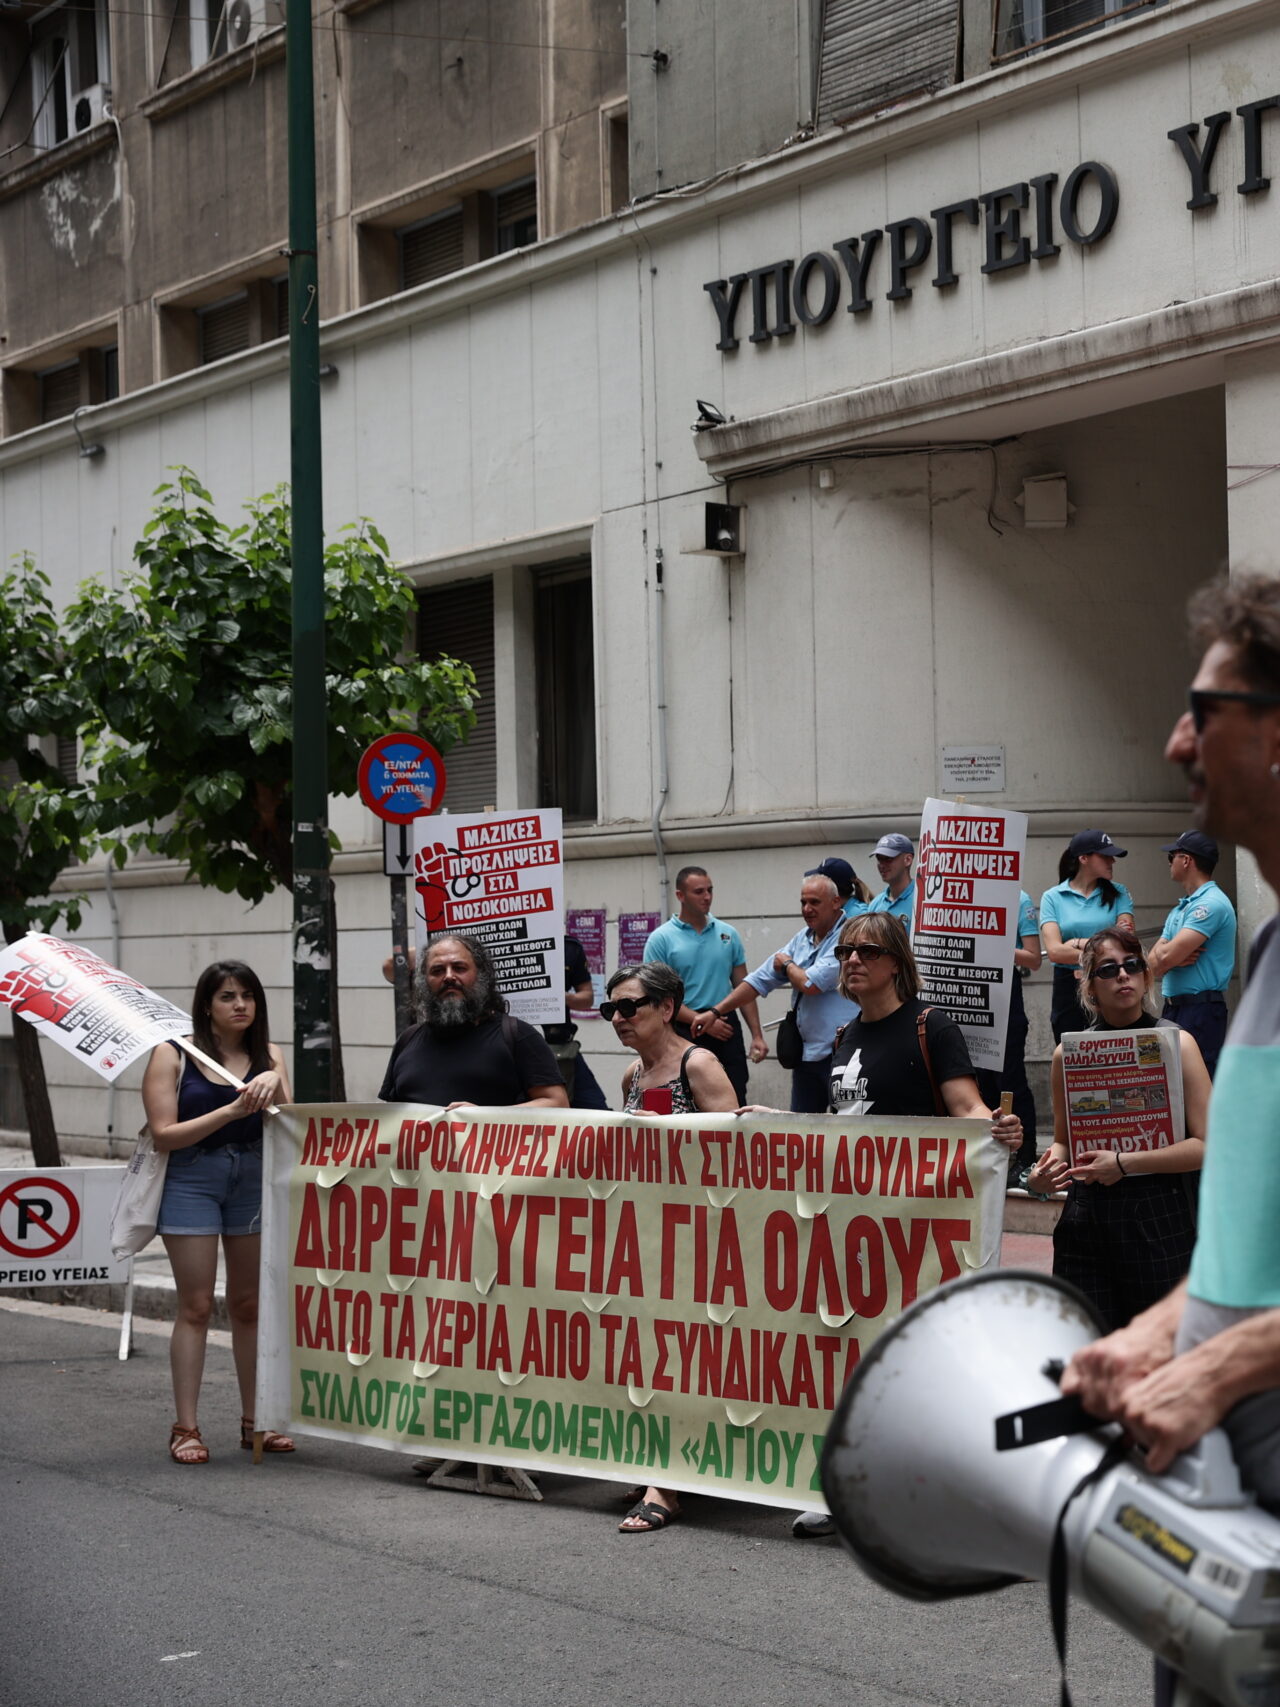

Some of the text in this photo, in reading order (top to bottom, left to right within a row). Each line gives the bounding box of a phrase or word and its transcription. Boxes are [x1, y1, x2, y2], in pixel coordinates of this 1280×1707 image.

[703, 161, 1120, 352] ΥΠΟΥΡΓΕΙΟ
[464, 820, 537, 848] ΜΑΖΙΚΕΣ
[940, 820, 1000, 843] ΜΑΖΙΚΕΣ
[450, 844, 555, 877] ΠΡΟΣΛΗΨΕΙΣ
[928, 852, 1015, 876] ΠΡΟΣΛΗΨΕΙΣ
[489, 874, 515, 892] ΣΤΑ
[946, 881, 969, 900] ΣΤΑ
[452, 892, 547, 921] ΝΟΣΟΚΟΜΕΙΑ
[499, 920, 523, 931] ΟΛΩΝ
[922, 907, 999, 931] ΝΟΣΟΚΟΜΕΙΑ
[475, 930, 517, 943] ΑΣΙΟΥΧΩΝ
[947, 938, 971, 949] ΟΛΩΝ
[487, 940, 551, 956] ΤΟΥΣ ΜΙΣΘΟΥΣ
[519, 956, 537, 966] ΤΩΝ
[495, 965, 542, 978] ΛΕΥΤΗΡΙΩΝ
[932, 965, 955, 977] ΣΤΟΥΣ
[957, 968, 999, 980] ΜΙΣΘΟΥΣ
[936, 982, 960, 994] ΟΛΩΝ
[962, 985, 981, 996] ΤΩΝ
[946, 1011, 989, 1024] ΑΣΤΟΛΩΝ
[1079, 1037, 1133, 1053] εργατικη
[1064, 1051, 1136, 1066] αλληλεγγυη
[301, 1117, 391, 1169] ΛΕΦΤΑ-
[397, 1120, 556, 1178] ΠΡΟΣΛΗΨΕΙΣ
[554, 1126, 661, 1184] ΜΟΝΙΜΗ
[699, 1130, 825, 1193] ΣΤΑΘΕΡΗ
[831, 1135, 974, 1199] ΔΟΥΛΕΙΑ
[294, 1182, 971, 1318] ΔΩΡΕΑΝ ΥΓΕΙΑ ΓΙΑ ΟΛΟΥΣ
[0, 1266, 109, 1283] ΡΓΕΙΟ ΥΓΕΙΑΣ
[295, 1284, 373, 1355] ΚΑΤΩ
[380, 1293, 416, 1361] ΤΑ
[417, 1296, 513, 1373] ΧΕΡΙΑ
[519, 1307, 591, 1381] ΑΠΟ
[600, 1314, 644, 1388] ΤΑ
[300, 1368, 426, 1436] ΣΥΛΛΟΓΟΣ
[433, 1388, 670, 1469] ΕΡΓΑΖΟΜΕΝΩΝ
[680, 1421, 804, 1488] «ΑΓΙΟΥ
